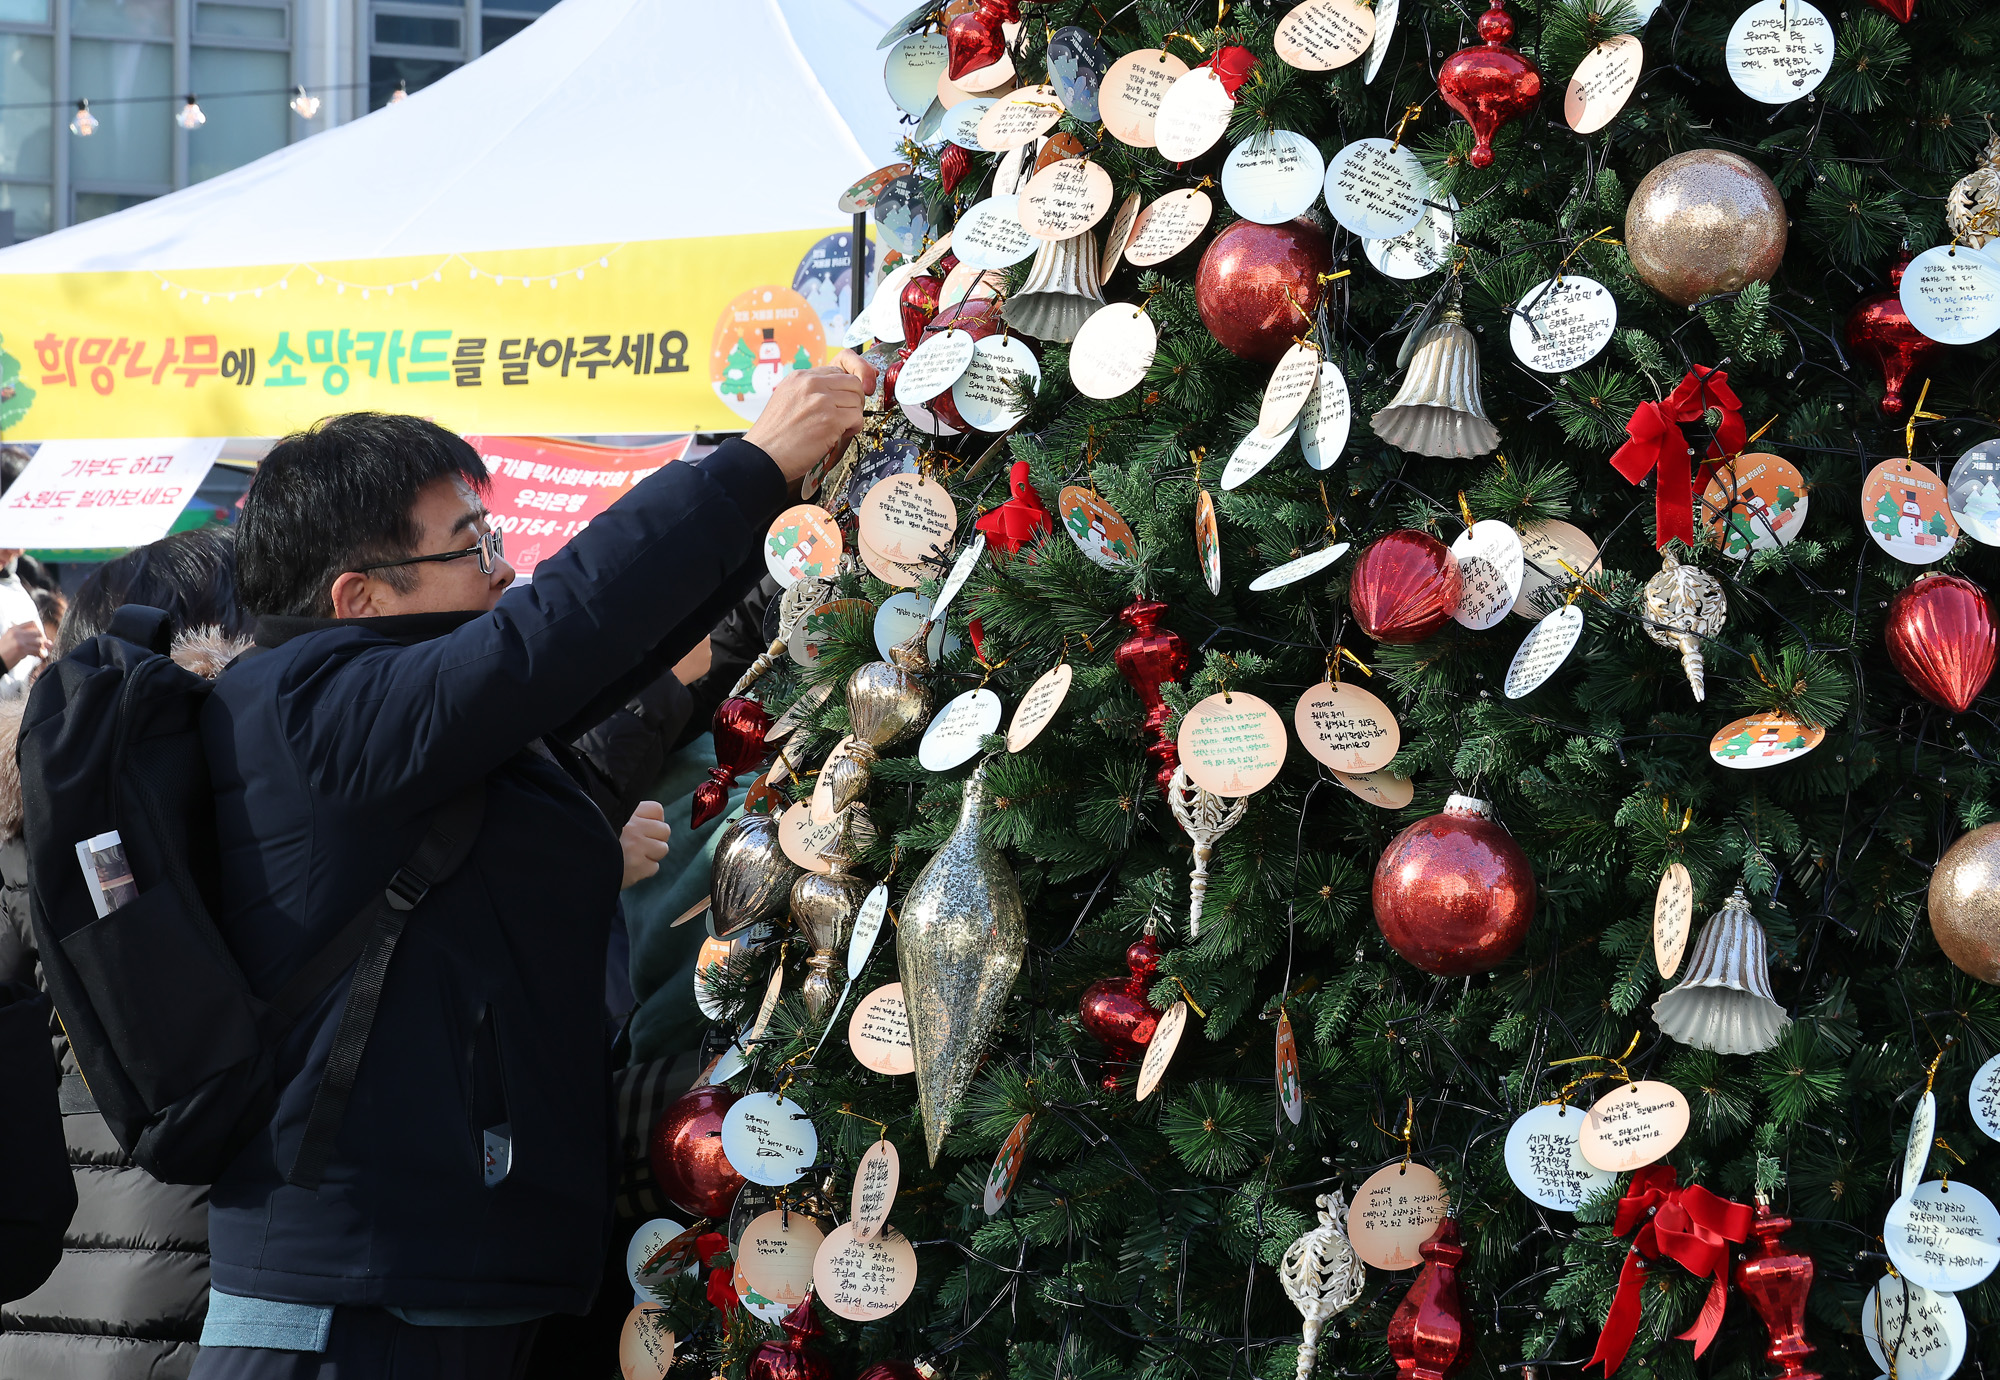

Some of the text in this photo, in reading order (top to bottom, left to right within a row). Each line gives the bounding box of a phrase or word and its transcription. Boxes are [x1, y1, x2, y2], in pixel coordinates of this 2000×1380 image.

[1789, 16, 1824, 27] 2026년
[1790, 31, 1805, 43] 모두
[1744, 46, 1780, 55] 건강하고
[1354, 151, 1367, 161] 모두
[1548, 313, 1585, 330] 행복하고
[1568, 318, 1611, 335] 무탈하길
[34, 328, 690, 396] 희망나무에 소망카드를 달아주세요
[1542, 353, 1587, 370] 건강하길
[61, 455, 174, 477] 기부도 하고
[9, 487, 183, 509] 소원도 빌어보세요
[514, 488, 589, 513] 우리은행
[1606, 1101, 1641, 1114] 사랑하는
[744, 1113, 771, 1127] 모두에게
[1618, 1124, 1651, 1136] 하늘에서
[1398, 1196, 1408, 1204] 모두
[1913, 1198, 1966, 1213] 항상 건강하고
[1909, 1210, 1946, 1223] 행복하게
[1365, 1220, 1375, 1230] 모두
[1945, 1227, 1984, 1237] 2026년도
[868, 1241, 884, 1250] 모두
[843, 1248, 866, 1259] 건강과
[832, 1268, 856, 1278] 주님의
[866, 1301, 899, 1311] 데레사
